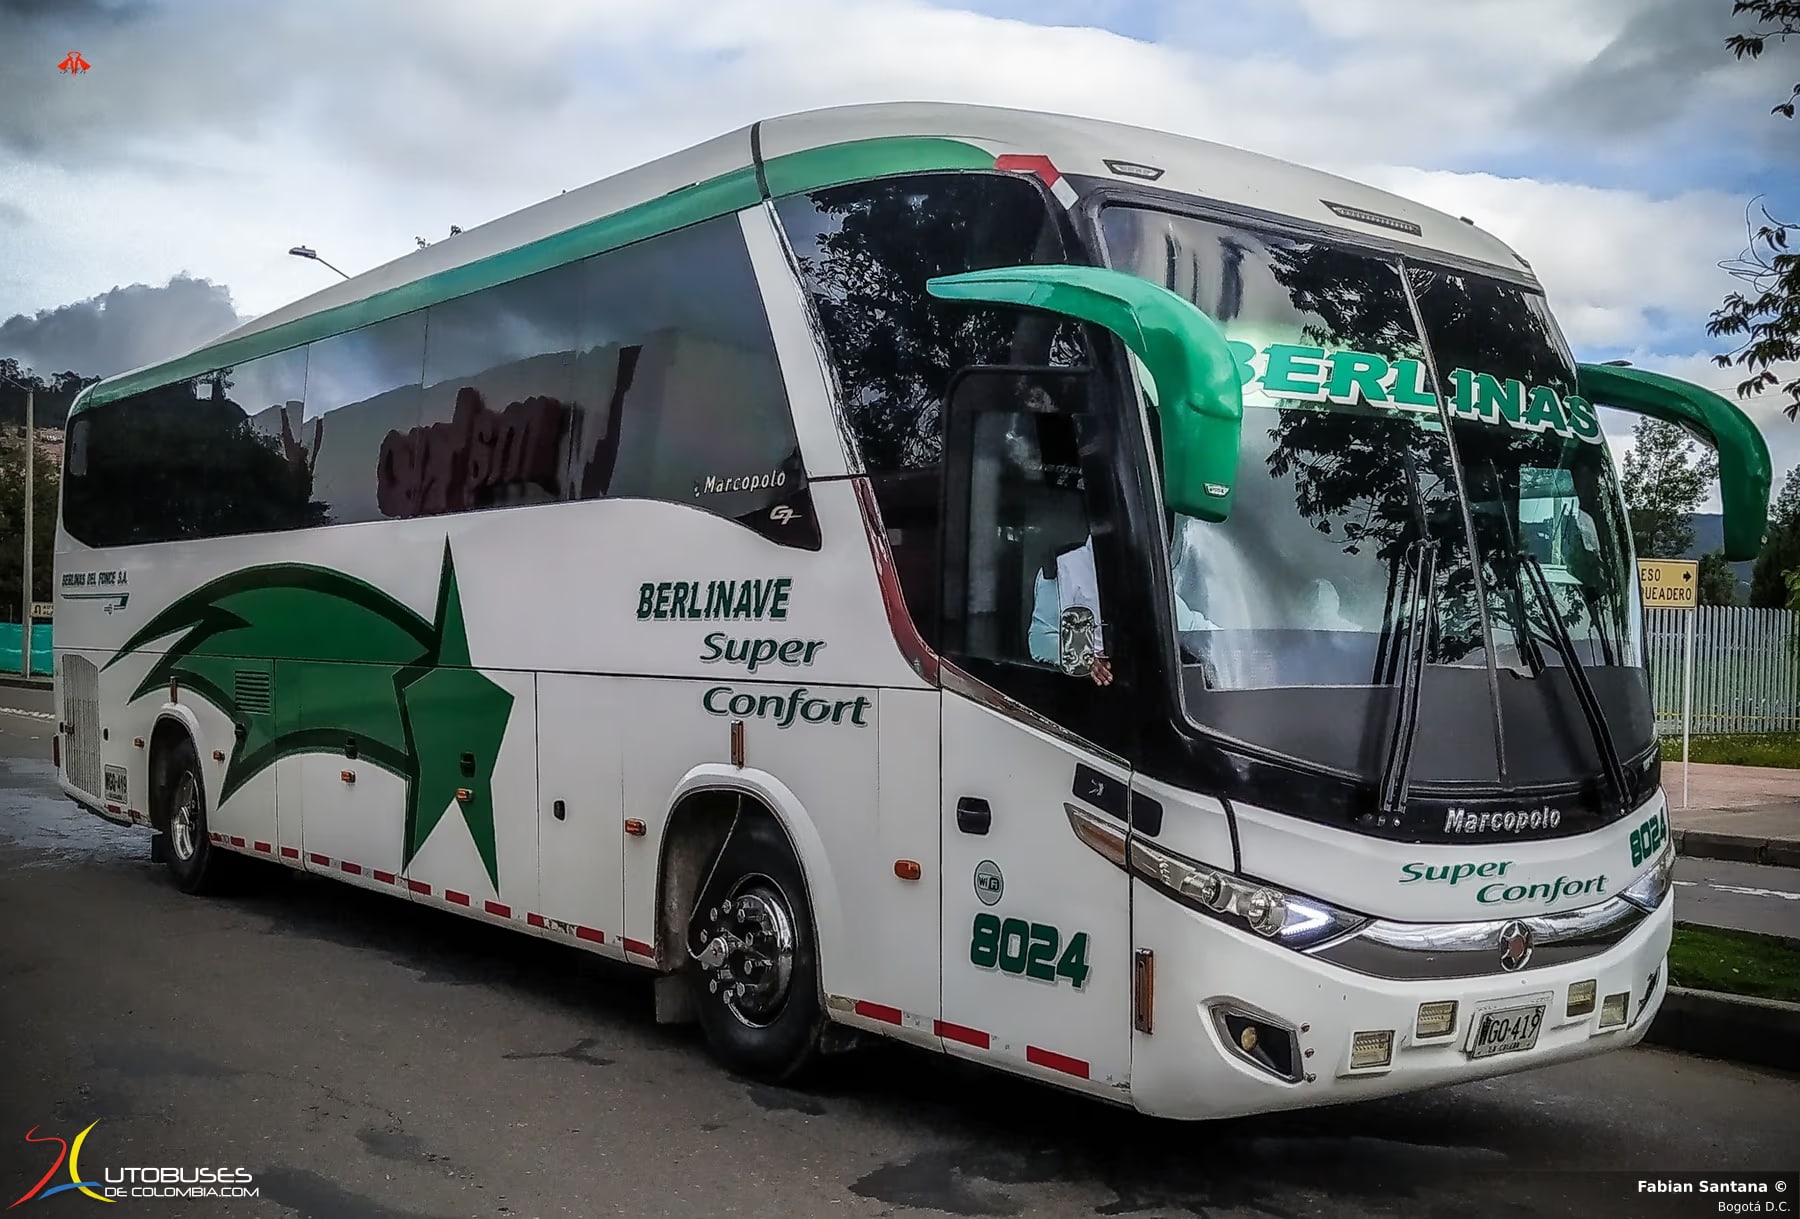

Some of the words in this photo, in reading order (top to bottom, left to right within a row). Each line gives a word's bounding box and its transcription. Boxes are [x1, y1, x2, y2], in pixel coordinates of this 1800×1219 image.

[703, 470, 786, 494] Marcopolo
[636, 577, 793, 622] BERLINAVE
[698, 631, 827, 673] Super
[702, 686, 872, 729] Confort
[1444, 806, 1561, 834] Marcopolo
[1628, 805, 1669, 868] 8024
[1398, 860, 1513, 884] Super
[1475, 873, 1608, 904] Confort
[970, 912, 1090, 990] 8024
